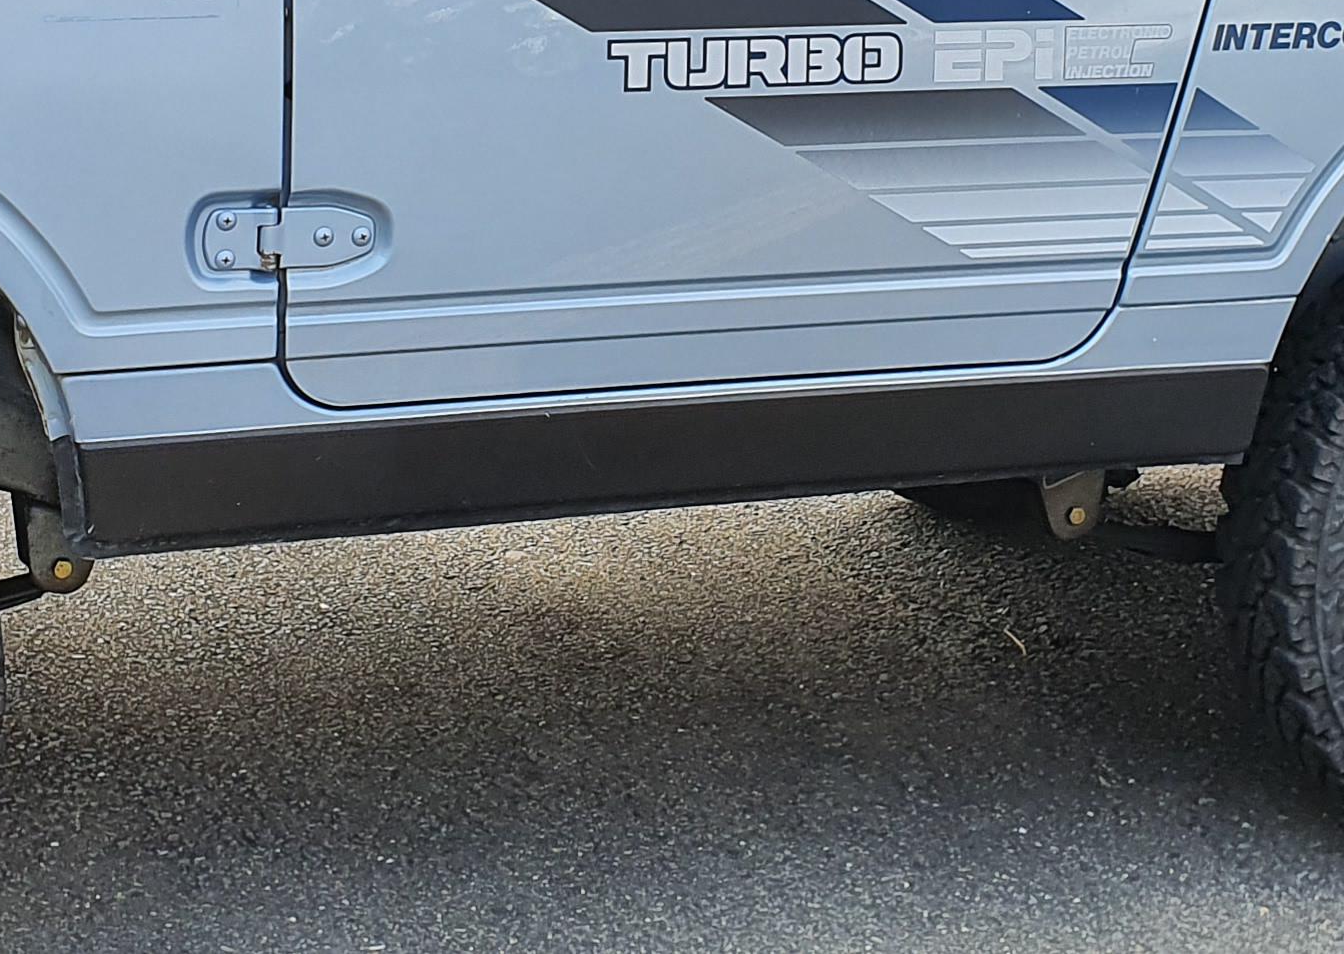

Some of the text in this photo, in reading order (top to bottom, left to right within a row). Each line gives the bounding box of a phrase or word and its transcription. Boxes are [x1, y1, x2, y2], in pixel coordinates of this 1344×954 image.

[1067, 26, 1171, 40] ELECTRONIC
[1066, 45, 1132, 60] PETROL
[608, 31, 904, 93] TURBO
[1064, 63, 1155, 79] INJECTION
